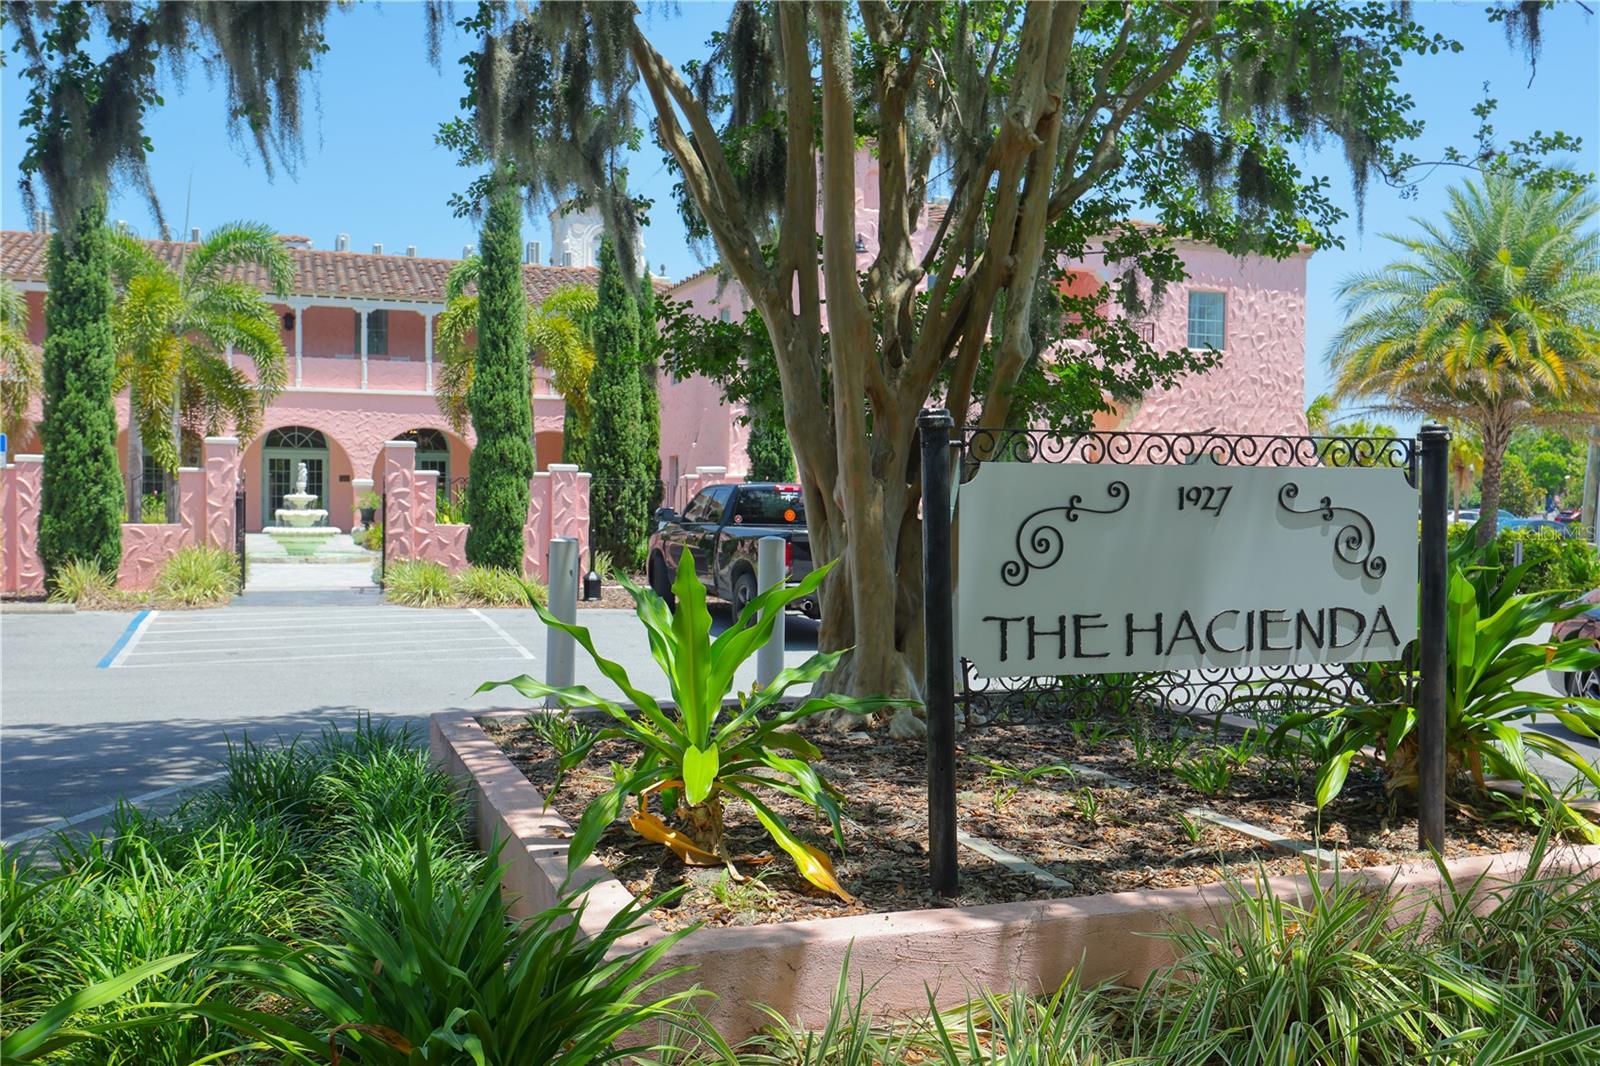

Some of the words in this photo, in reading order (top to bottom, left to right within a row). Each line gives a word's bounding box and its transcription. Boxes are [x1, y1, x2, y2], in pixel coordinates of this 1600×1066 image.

[1177, 485, 1233, 517] 1927
[982, 613, 1110, 662] THE
[1125, 604, 1401, 658] HACIENDA
